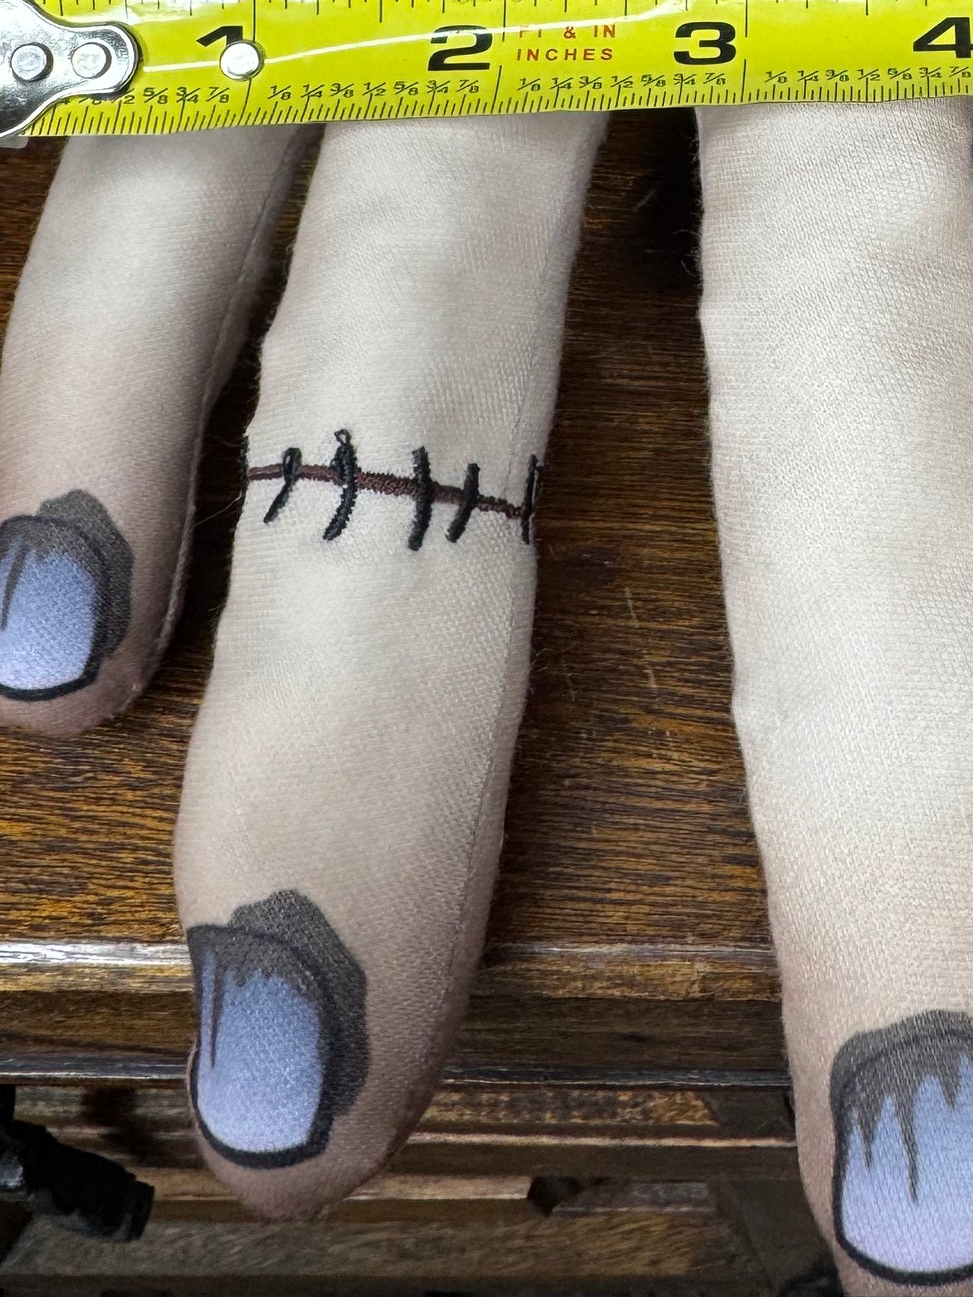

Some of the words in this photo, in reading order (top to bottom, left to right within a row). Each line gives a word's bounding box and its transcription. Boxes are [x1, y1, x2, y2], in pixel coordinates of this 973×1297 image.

[564, 26, 576, 39] &
[594, 23, 615, 38] IN
[673, 21, 737, 66] 3
[428, 25, 493, 71] 2
[517, 48, 613, 61] INCHES
